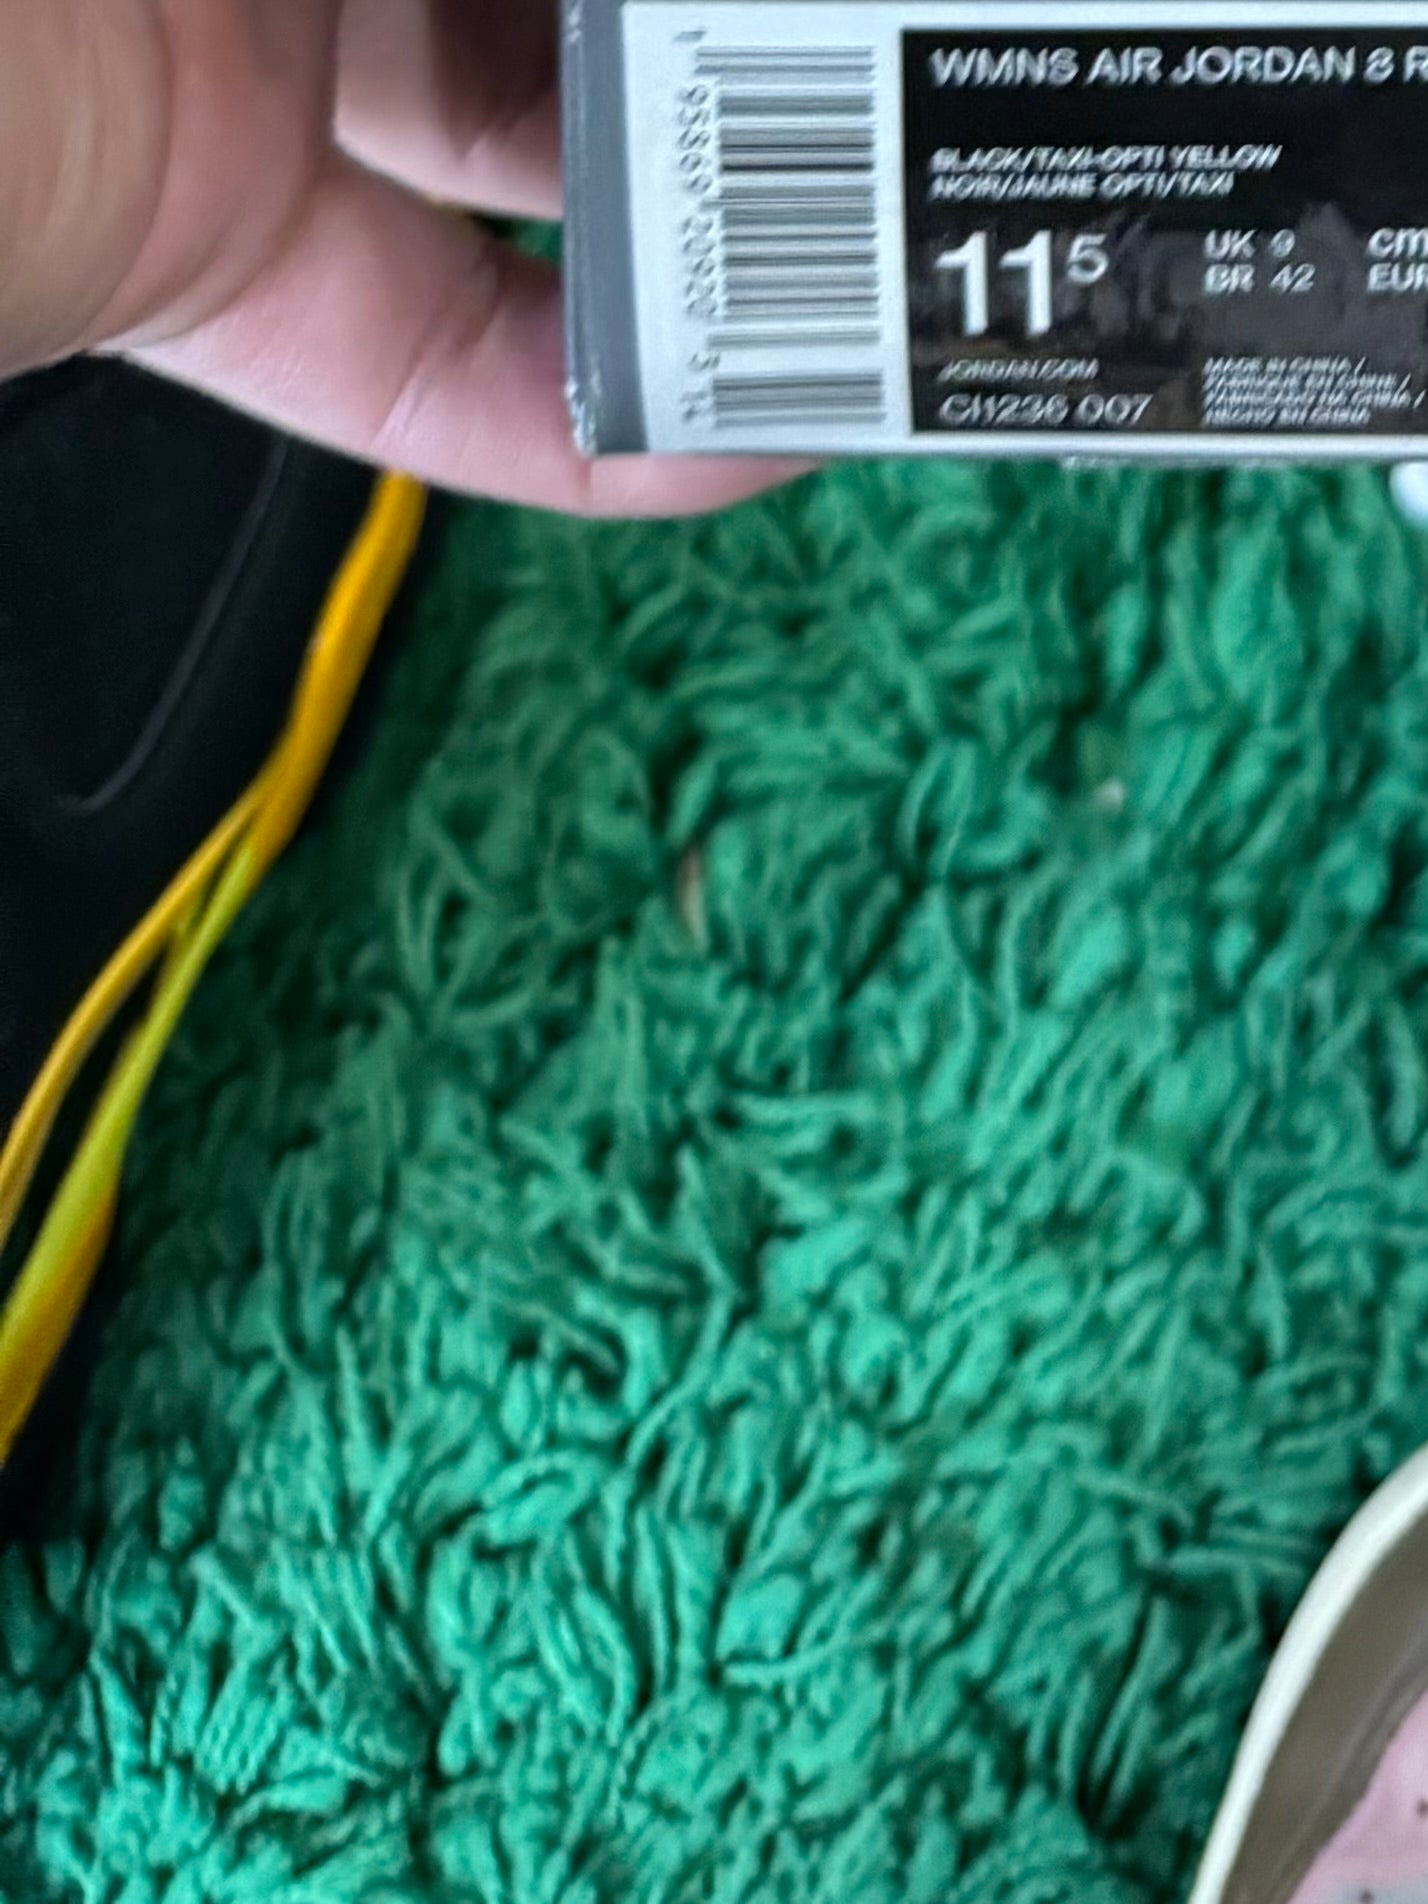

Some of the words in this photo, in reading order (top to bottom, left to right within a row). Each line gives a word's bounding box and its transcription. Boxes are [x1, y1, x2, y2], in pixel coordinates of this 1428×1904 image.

[930, 47, 1079, 86] WMNS
[1086, 47, 1165, 85] AIR
[1170, 46, 1357, 85] JORDAN
[1364, 47, 1396, 84] 8
[1168, 143, 1283, 170] YELLOW
[1204, 229, 1257, 261] UK
[1204, 263, 1255, 296] BR
[1269, 262, 1316, 293] 42
[1073, 392, 1154, 425] 007
